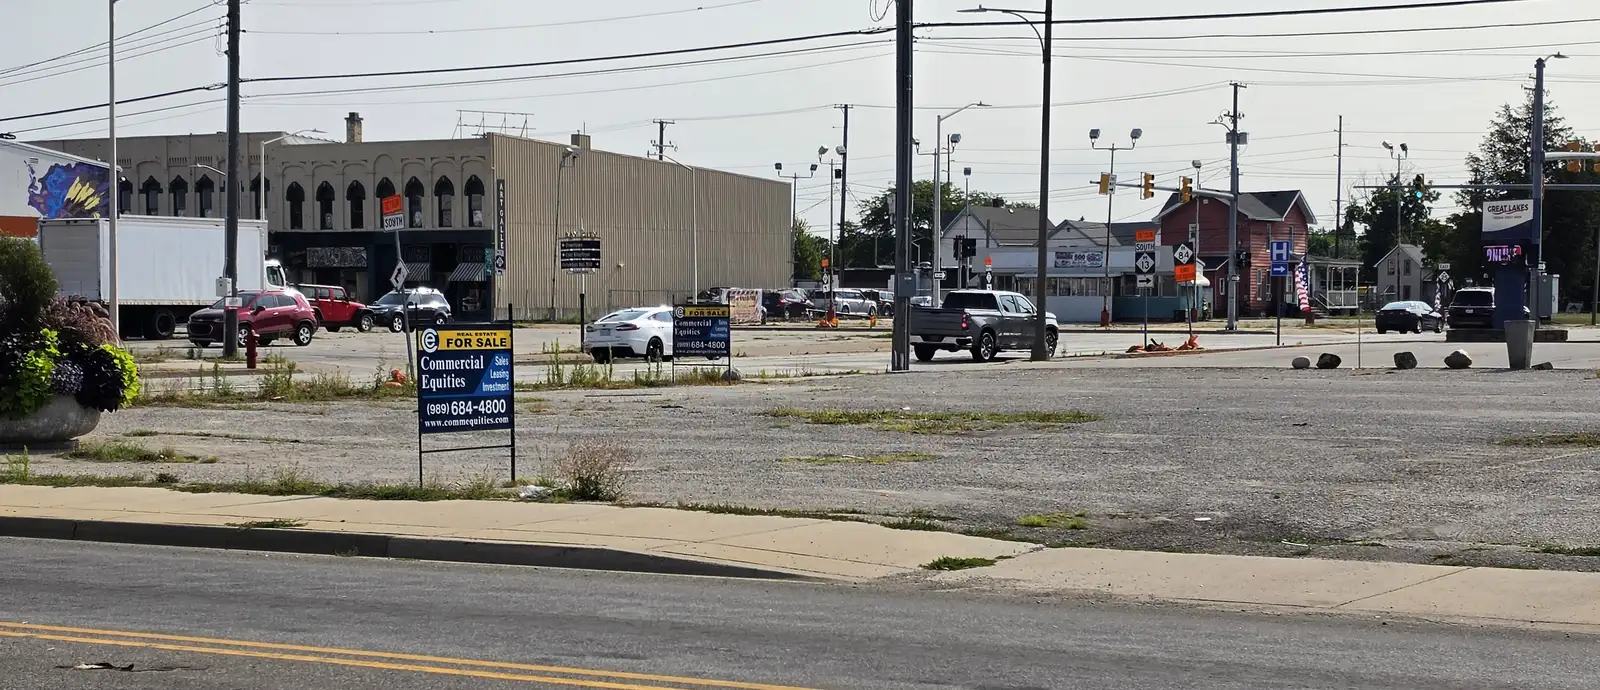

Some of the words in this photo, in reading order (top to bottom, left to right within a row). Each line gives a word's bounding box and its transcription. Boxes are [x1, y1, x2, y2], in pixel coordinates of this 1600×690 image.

[1487, 205, 1507, 213] GREAT
[1509, 203, 1529, 211] LAKES
[385, 217, 402, 228] SOUTH
[1136, 243, 1154, 251] SOUTH
[1272, 242, 1288, 261] H
[1179, 250, 1190, 260] 84
[1141, 260, 1150, 270] 13
[674, 319, 711, 327] Commercial
[674, 327, 701, 336] Equities
[446, 338, 473, 348] FOR
[476, 337, 507, 347] SALE
[691, 341, 726, 349] 684-4800
[420, 355, 484, 371] Commercial
[494, 355, 509, 366] Sales
[490, 369, 510, 380] Leasing
[421, 373, 466, 392] Equities
[482, 382, 510, 392] Investment
[426, 402, 450, 415] (989)
[451, 399, 506, 415] 684-4800
[424, 416, 509, 428] www.commequities.com
